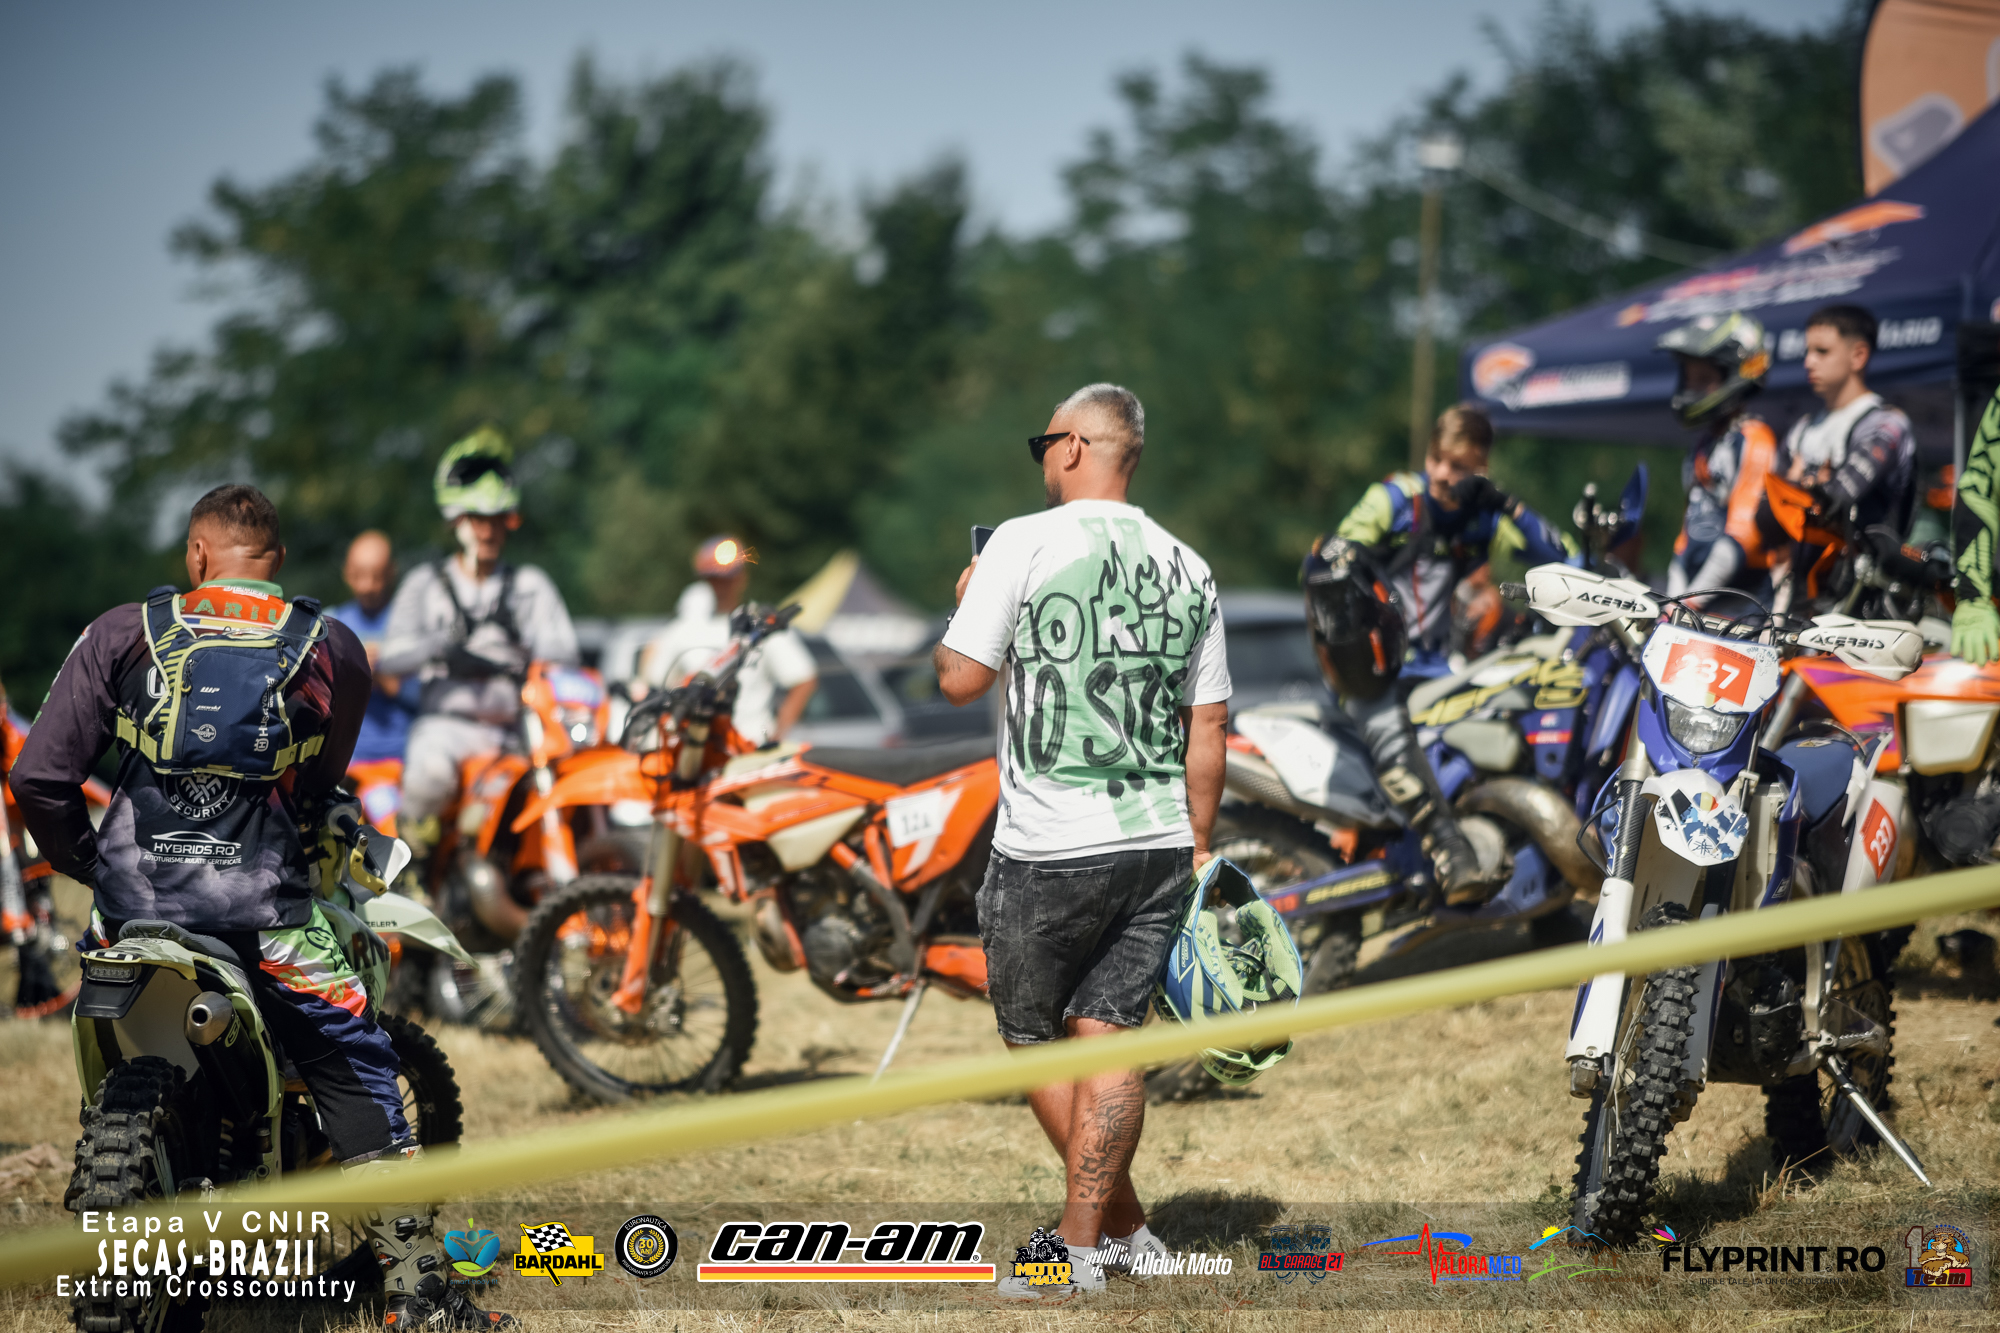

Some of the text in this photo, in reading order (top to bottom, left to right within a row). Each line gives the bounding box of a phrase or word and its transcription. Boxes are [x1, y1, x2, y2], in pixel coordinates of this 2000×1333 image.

[179, 598, 284, 623] ARIU
[1577, 592, 1648, 614] ACERBIS
[1810, 633, 1885, 650] ACERBIS
[1675, 653, 1741, 690] 237
[170, 793, 230, 819] SECURITY
[153, 842, 236, 856] HYBRIDS.RO
[1870, 815, 1896, 867] 237
[143, 853, 184, 863] AUTOTURISME
[207, 857, 242, 866] CERTIFICATE
[1143, 1240, 1163, 1260] PUM
